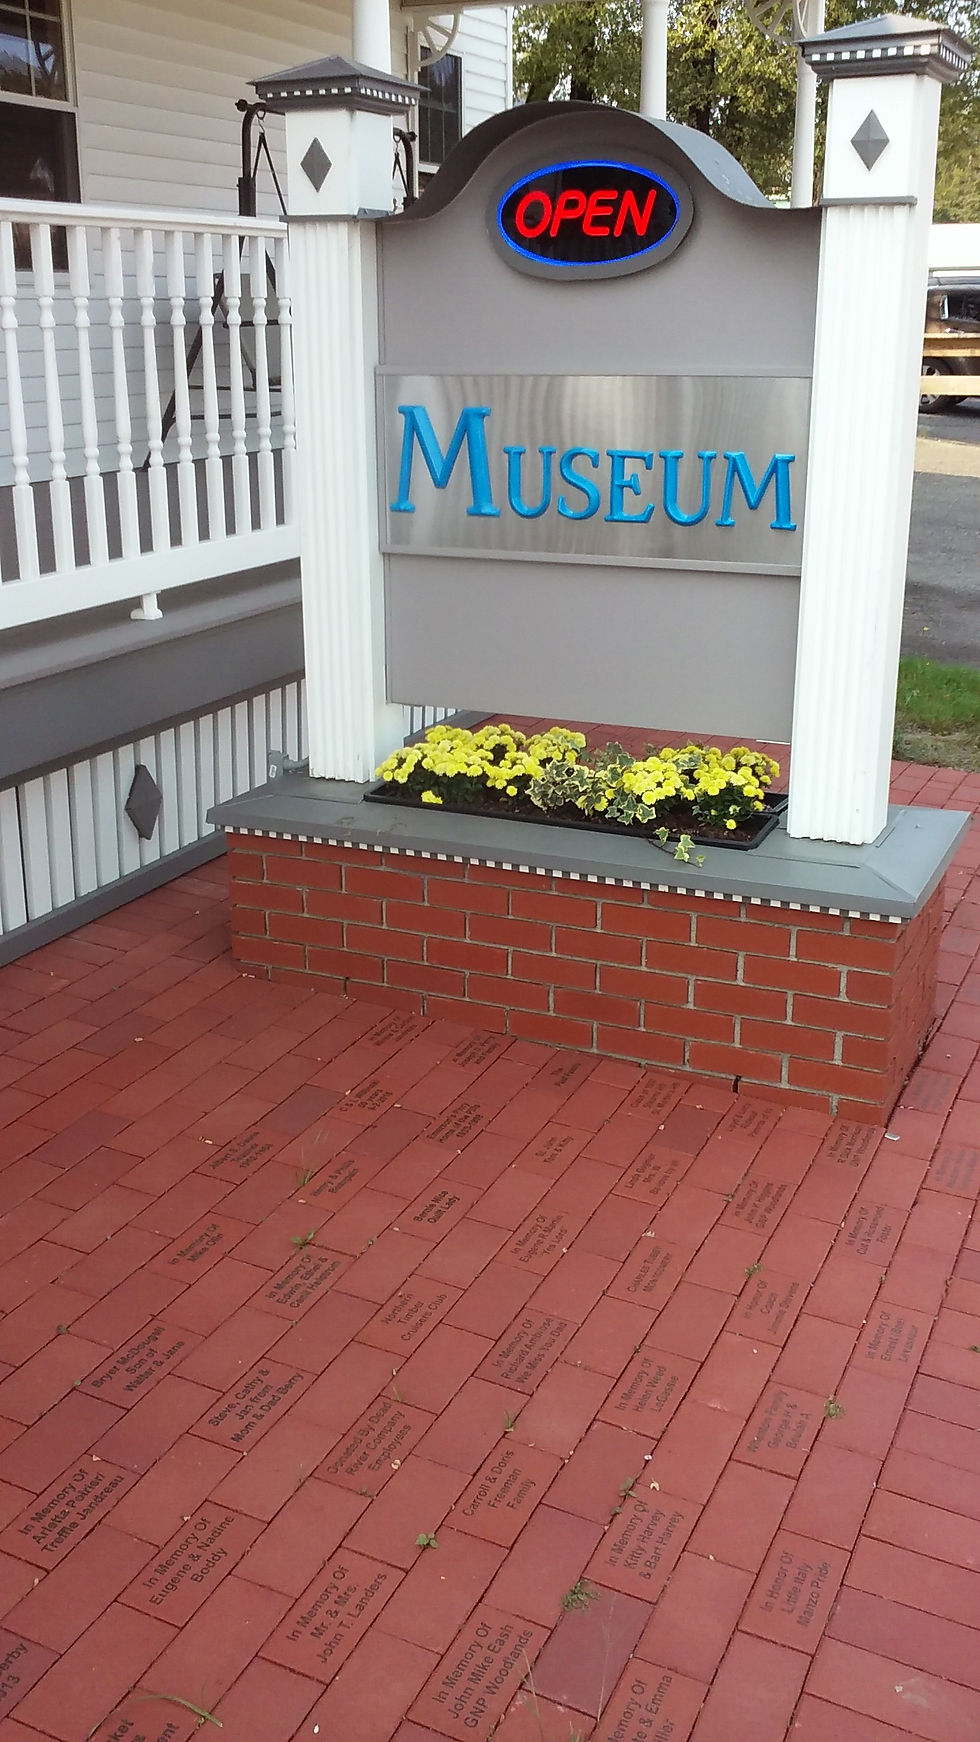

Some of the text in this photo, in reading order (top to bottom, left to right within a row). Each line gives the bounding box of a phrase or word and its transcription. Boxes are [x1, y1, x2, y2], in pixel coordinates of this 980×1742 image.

[515, 189, 657, 238] OPEN
[390, 405, 797, 531] MUSEUM
[425, 1292, 448, 1311] Club
[124, 1356, 149, 1375] Son
[151, 1358, 165, 1367] &
[160, 1339, 186, 1360] Jane
[490, 1318, 535, 1368] In Memory Of
[89, 1364, 123, 1389] Bryer
[206, 1368, 271, 1427] Steve, Cathy &
[619, 1367, 650, 1402] Memory
[228, 1371, 306, 1443] Mom & Dad Berry
[366, 1401, 393, 1424] Dead
[613, 1400, 628, 1411] In
[343, 1409, 407, 1475] River Company
[16, 1468, 91, 1535] In Memory Of
[460, 1449, 516, 1517] Carroll & Doris
[486, 1466, 523, 1509] Freeman
[505, 1477, 538, 1511] Family
[141, 1516, 213, 1589] In Memory Of
[603, 1499, 650, 1567] In Memory Of
[636, 1508, 667, 1545] Harvey
[638, 1570, 652, 1580] &
[655, 1510, 686, 1547] Harvey
[147, 1561, 195, 1607] Eugene
[186, 1551, 202, 1562] &
[188, 1545, 230, 1585] Boddy
[759, 1549, 796, 1613] In Honor Of
[809, 1560, 832, 1590] Pride
[284, 1564, 350, 1642] In Memory Of
[309, 1580, 360, 1639] Mr. & Mrs.
[313, 1571, 388, 1664] John T. Landers
[431, 1621, 493, 1704] In Memory Of
[444, 1622, 514, 1720] John Mike Eash
[461, 1627, 533, 1730] GNP Woodlands
[631, 1679, 647, 1695] Of
[645, 1675, 673, 1715] Emma
[638, 1717, 653, 1728] &
